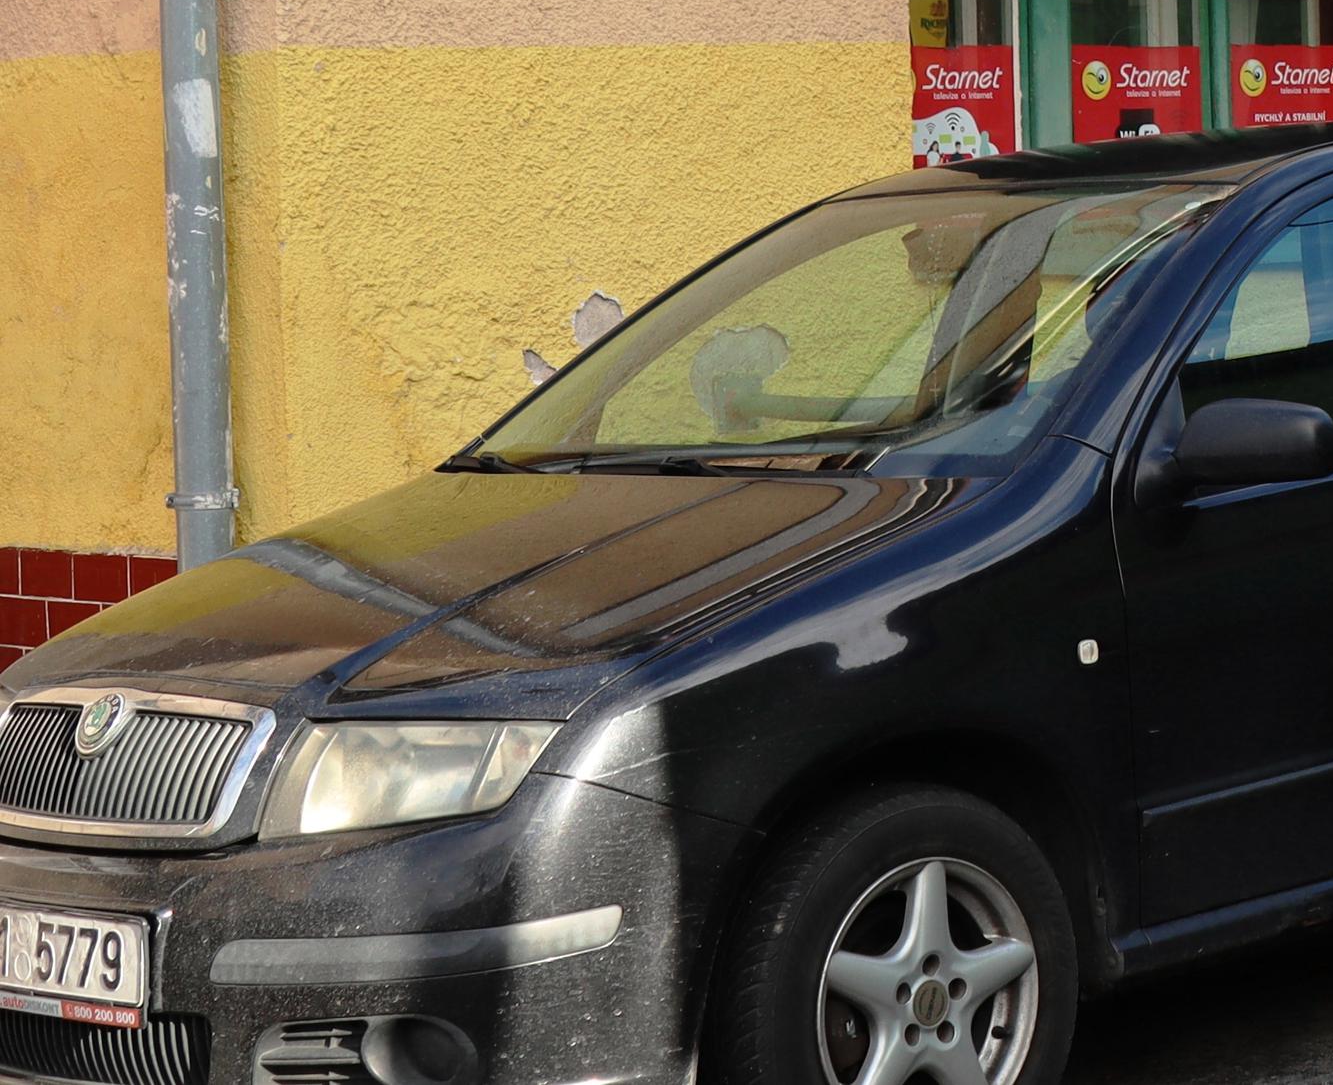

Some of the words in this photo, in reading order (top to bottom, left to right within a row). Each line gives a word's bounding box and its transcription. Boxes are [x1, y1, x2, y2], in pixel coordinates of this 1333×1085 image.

[922, 64, 1003, 90] Starnet
[1116, 63, 1191, 88] Starnet
[1254, 112, 1283, 123] RYCHLÝ
[1285, 113, 1291, 122] A
[1292, 110, 1326, 122] STABILNÍ
[36, 918, 124, 992] 5779
[74, 1006, 92, 1020] 800
[95, 1008, 114, 1023] 200
[116, 1011, 135, 1025] 800
